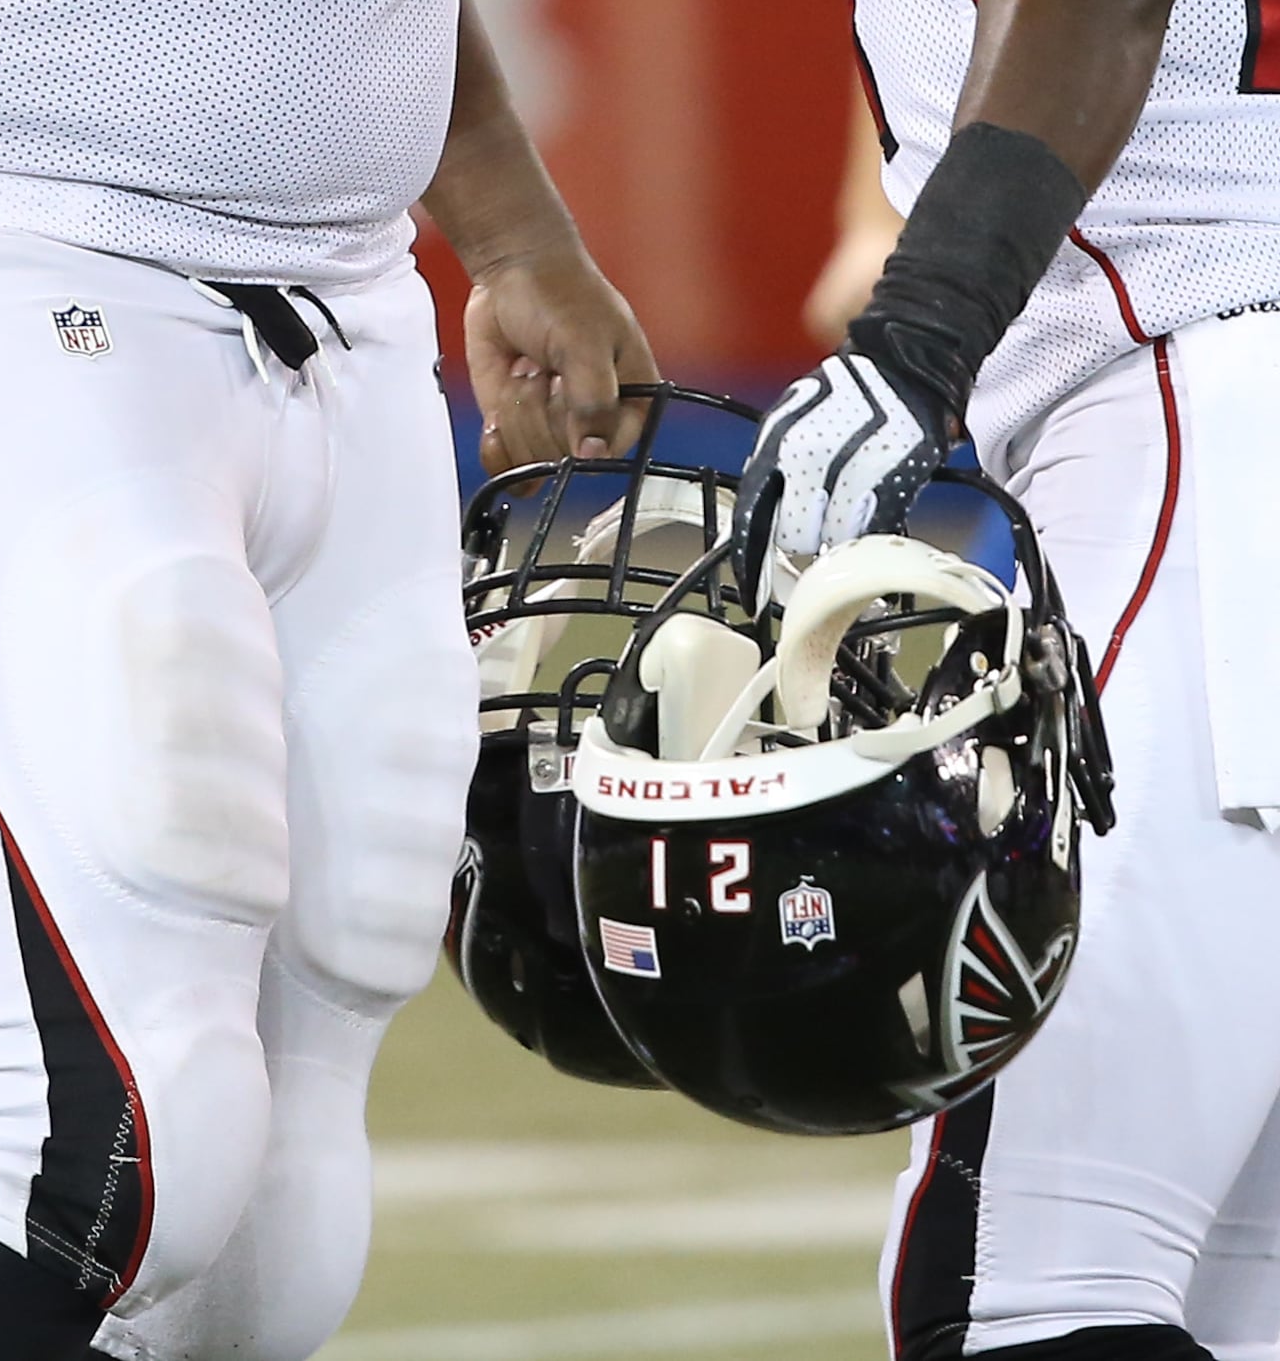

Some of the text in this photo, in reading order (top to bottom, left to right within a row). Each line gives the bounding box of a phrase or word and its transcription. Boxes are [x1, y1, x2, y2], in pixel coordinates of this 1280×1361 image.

[62, 328, 106, 352] NFL
[597, 771, 786, 800] FALCONS
[786, 892, 825, 919] NFL
